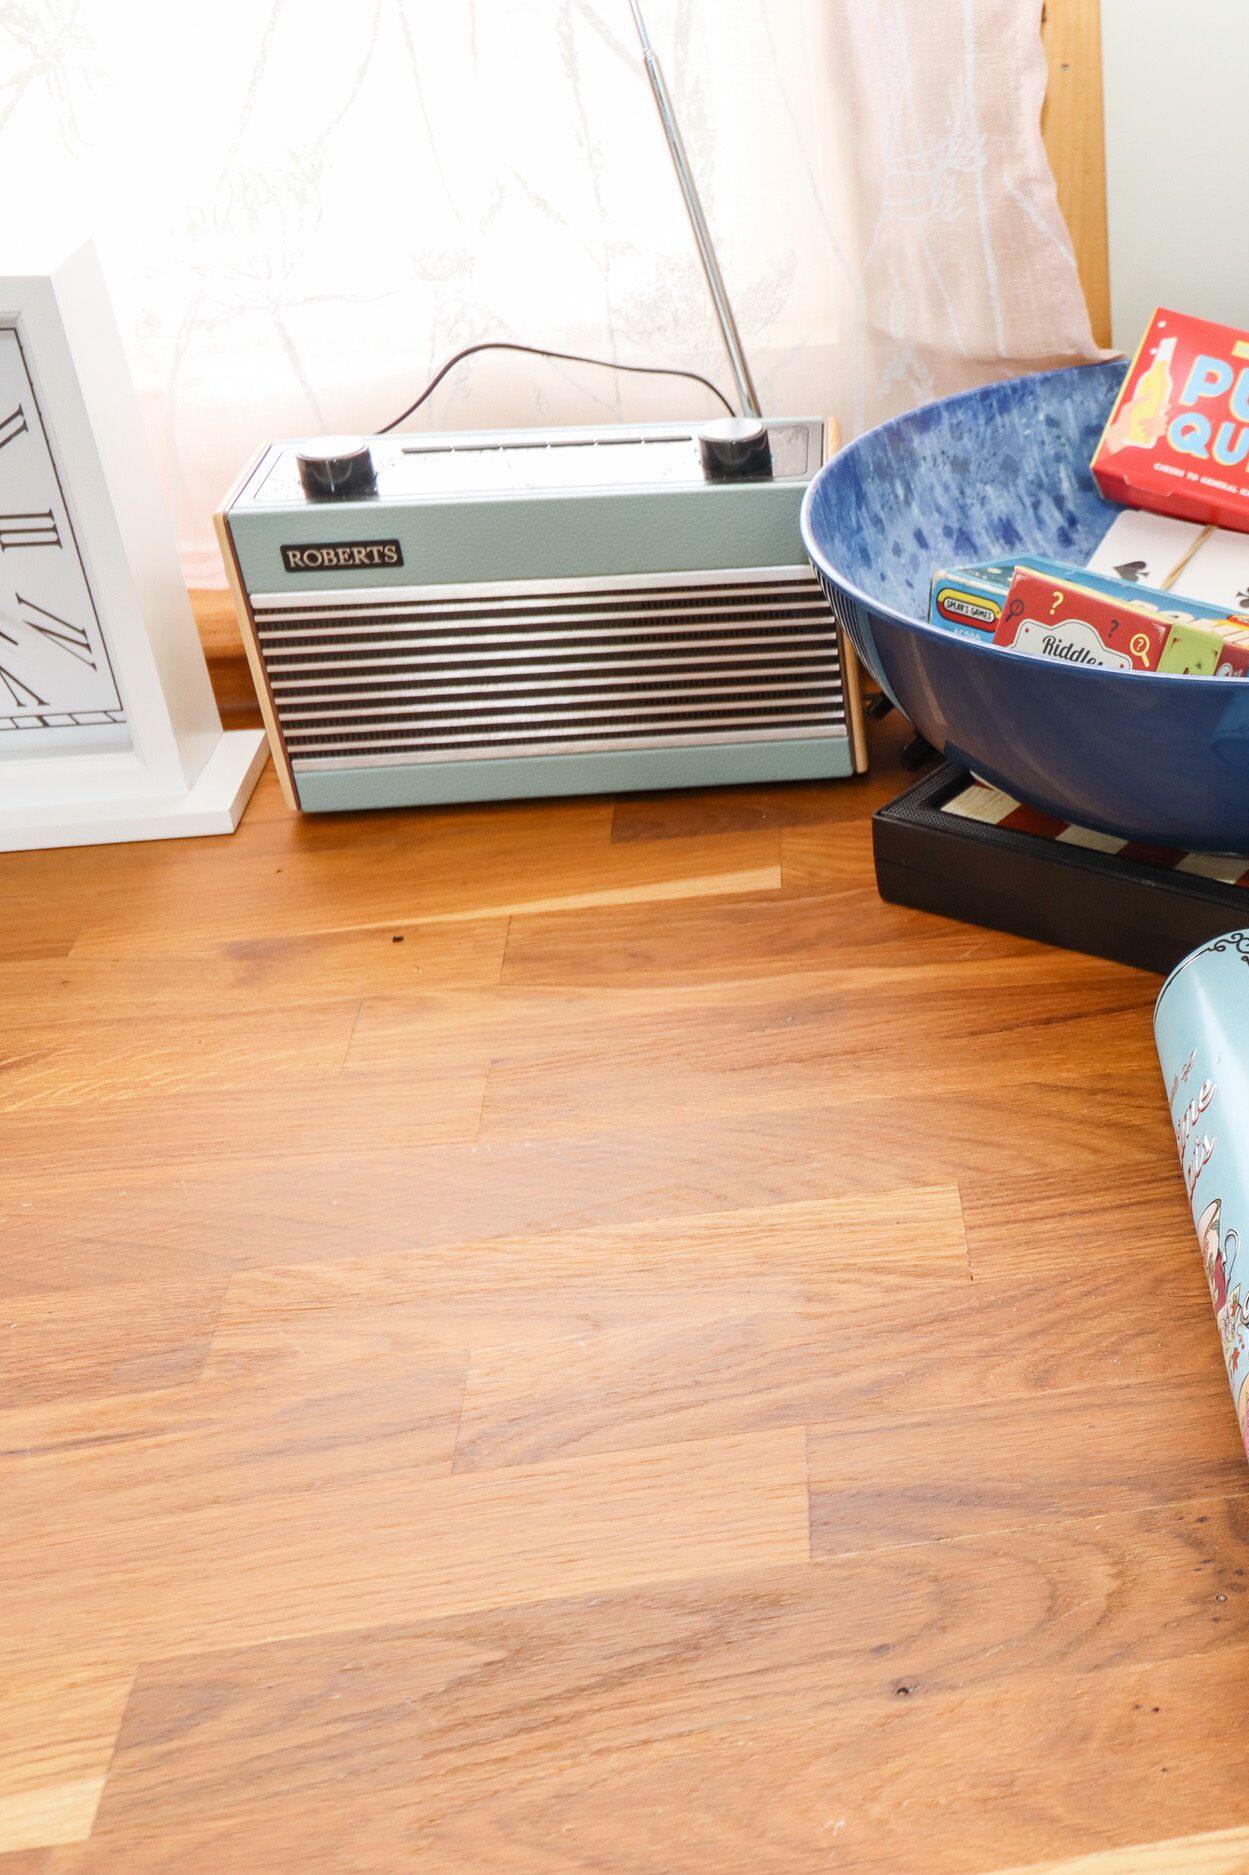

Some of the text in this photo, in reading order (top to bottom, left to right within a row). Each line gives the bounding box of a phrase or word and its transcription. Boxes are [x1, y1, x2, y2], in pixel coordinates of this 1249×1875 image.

[286, 544, 398, 569] ROBERTS
[970, 606, 993, 621] GAMES
[1041, 634, 1104, 667] Riddle
